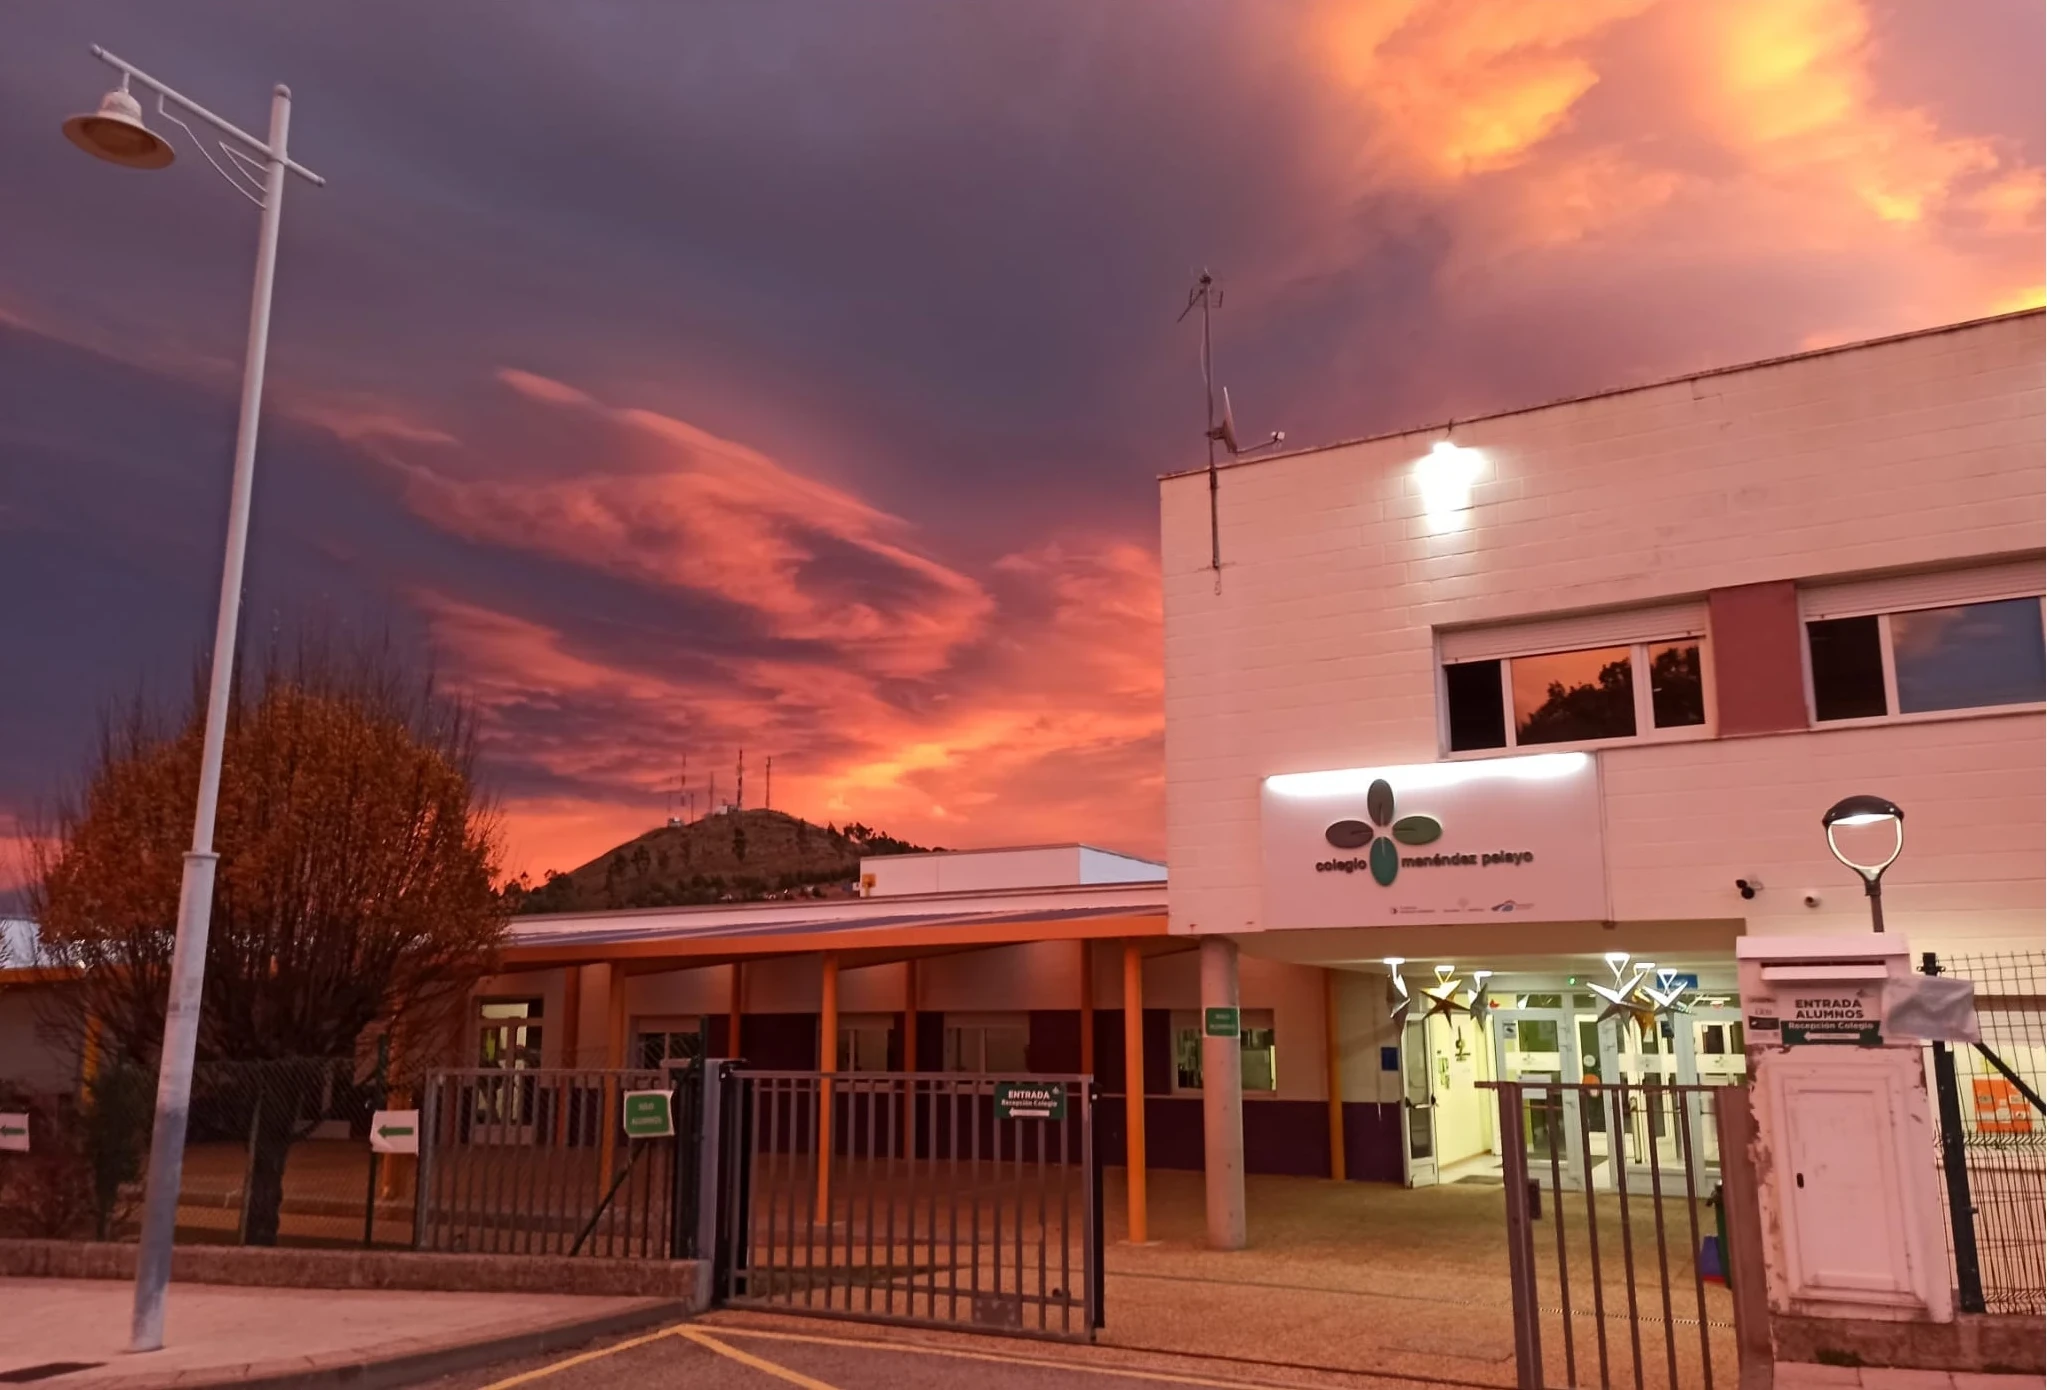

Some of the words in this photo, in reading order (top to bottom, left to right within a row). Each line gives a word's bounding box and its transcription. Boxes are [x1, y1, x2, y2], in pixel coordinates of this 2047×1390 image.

[1315, 857, 1367, 873] colegio
[1401, 853, 1477, 868] menéndez
[1481, 850, 1533, 868] pelayo
[1795, 999, 1862, 1009] ENTRADA
[1796, 1009, 1864, 1019] ALUMNOS
[1788, 1021, 1836, 1030] Recepción
[1838, 1021, 1874, 1030] Colegio
[1008, 1090, 1050, 1099] ENTRADA
